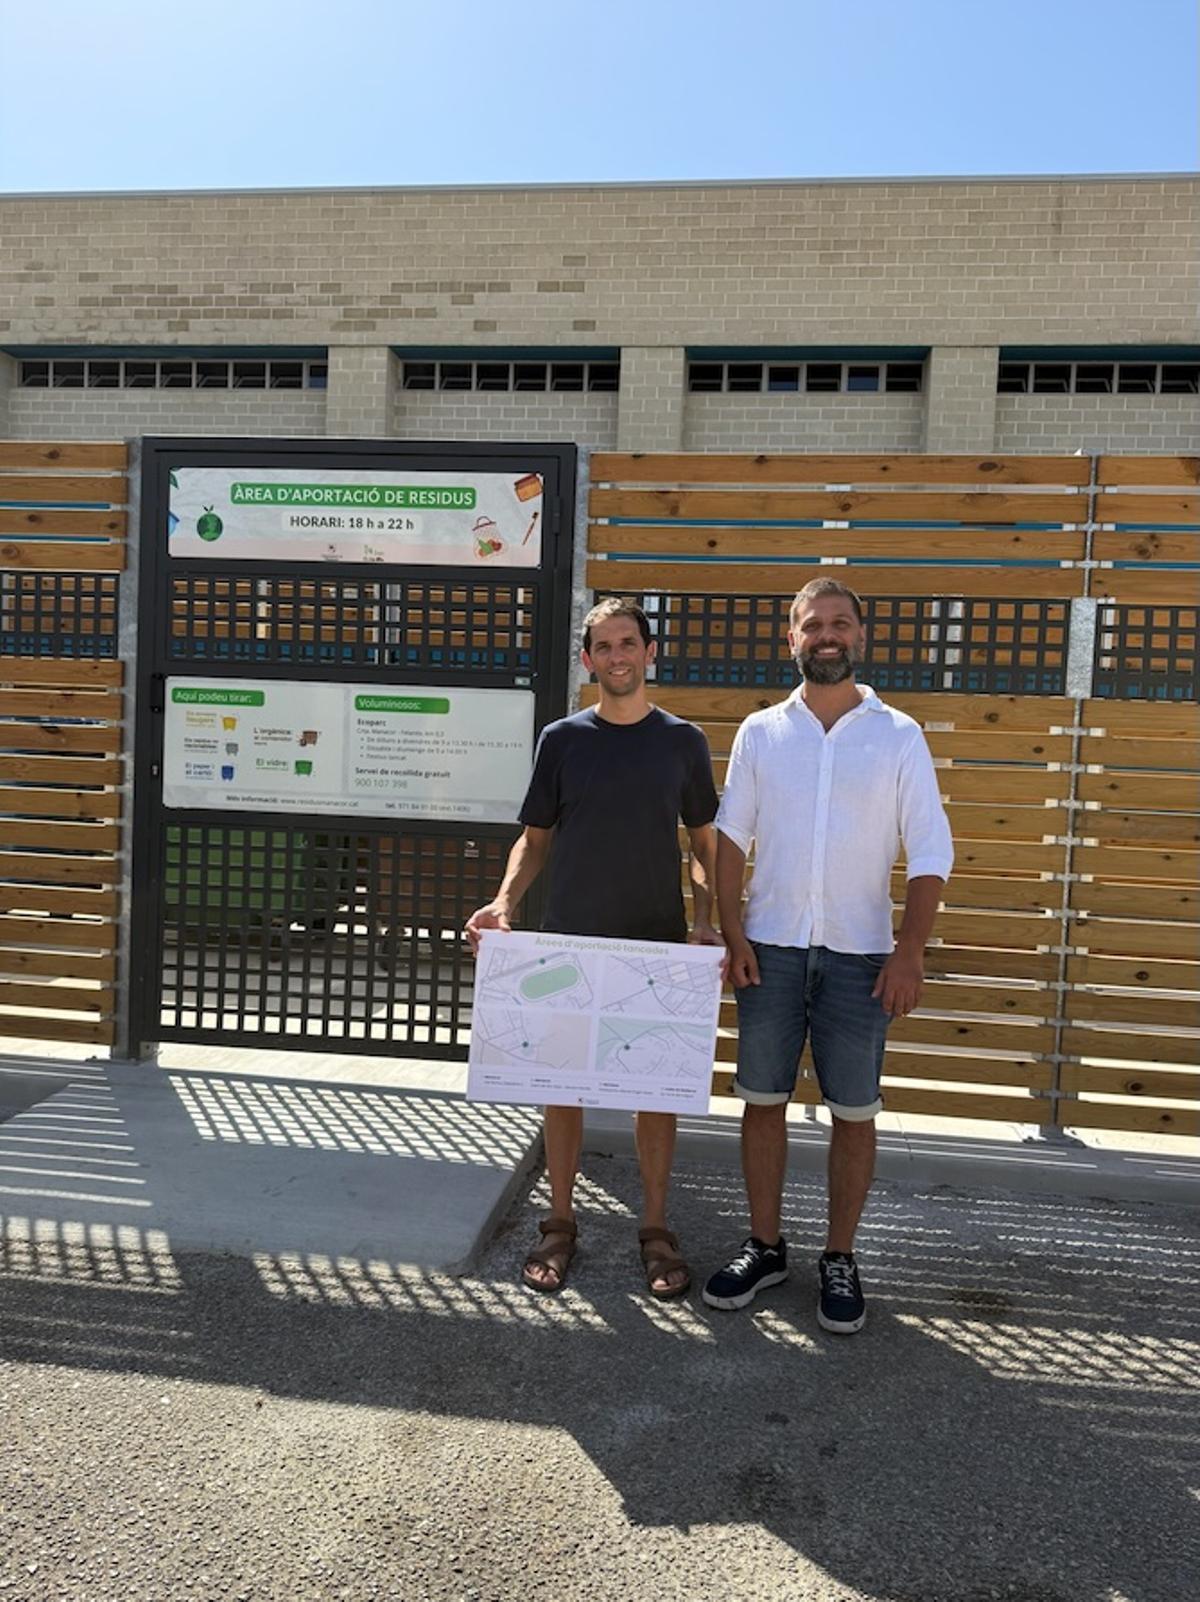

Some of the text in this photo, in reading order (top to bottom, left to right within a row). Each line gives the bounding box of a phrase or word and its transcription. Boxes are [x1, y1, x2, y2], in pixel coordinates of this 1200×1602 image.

[234, 484, 473, 505] ÀREA D'APORTACIÓ DE RESIDUS
[289, 516, 414, 531] HORARI: 18 h a 22 h
[198, 692, 228, 703] podeu
[229, 693, 252, 703] tirar:
[358, 698, 422, 711] Voluminosos:
[357, 718, 387, 727] Ecoparc
[256, 758, 264, 766] El
[355, 767, 378, 776] Servei
[380, 767, 390, 776] de
[390, 768, 423, 778] recollida
[355, 777, 371, 788] 900
[374, 778, 388, 788] 107
[565, 939, 623, 954] d'aportació
[624, 943, 669, 956] tancades
